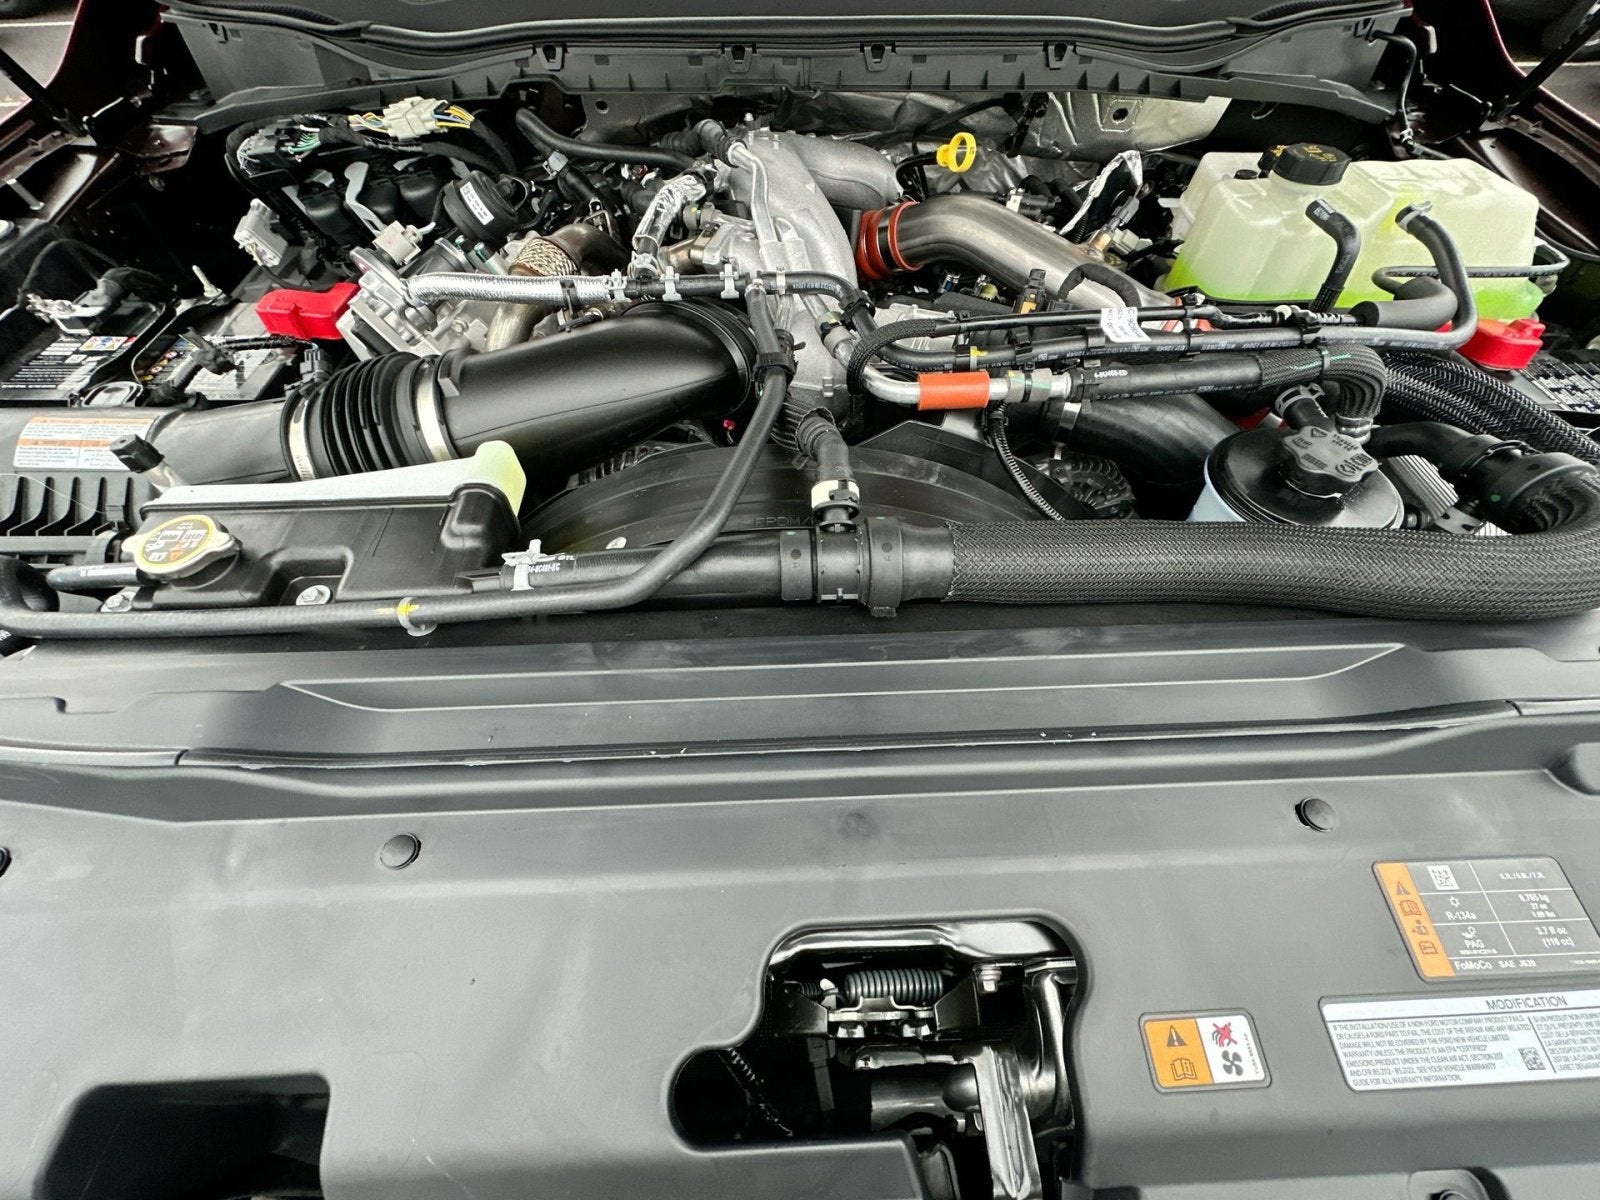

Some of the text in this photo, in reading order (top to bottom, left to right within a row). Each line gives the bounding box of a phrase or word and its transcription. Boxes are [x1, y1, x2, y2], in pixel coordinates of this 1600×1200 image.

[1445, 911, 1477, 920] R-134a
[1464, 940, 1484, 948] PAG
[1561, 937, 1575, 947] cc)
[1454, 961, 1492, 970] FoMoCo
[1486, 996, 1568, 1010] MODIFICATION
